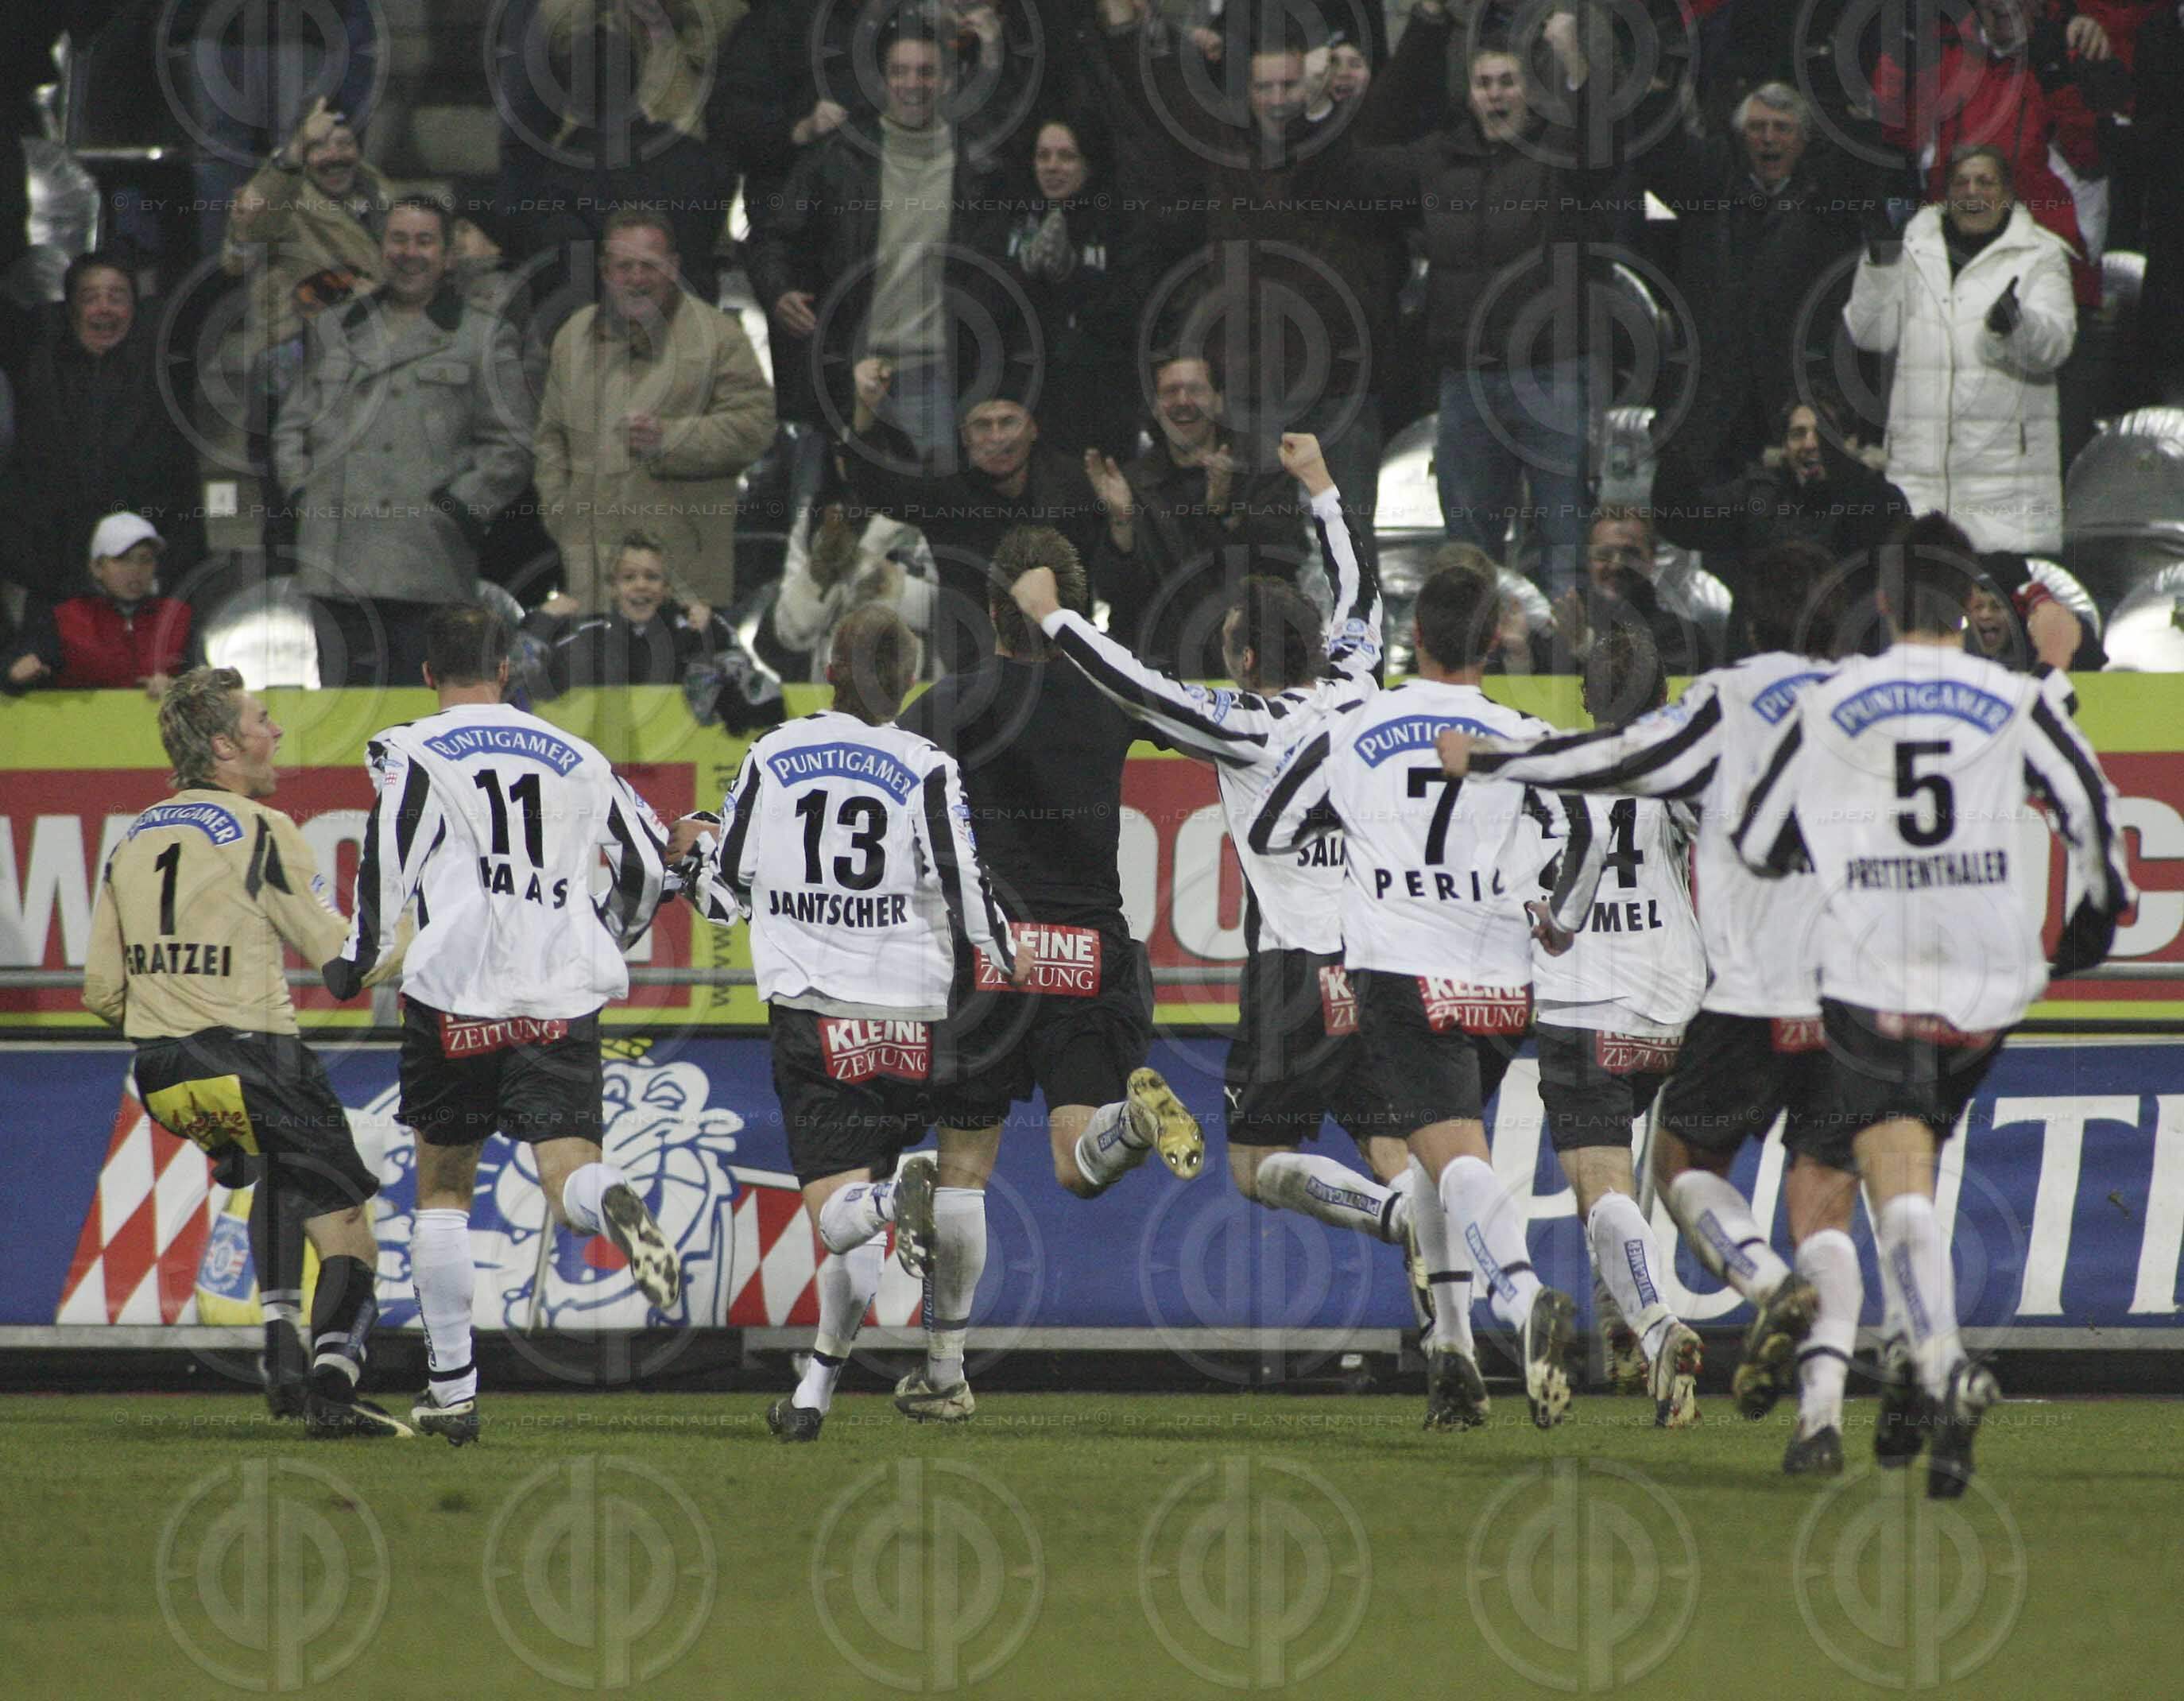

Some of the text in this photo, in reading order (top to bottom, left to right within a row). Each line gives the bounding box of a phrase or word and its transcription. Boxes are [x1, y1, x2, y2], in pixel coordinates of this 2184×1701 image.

[432, 729, 576, 771] PUNTIGAMER
[1358, 720, 1486, 760] PUNTI
[773, 748, 912, 798] PUNTIGAMER
[1895, 740, 1954, 848] 5
[472, 769, 544, 869] 11
[1407, 766, 1465, 865] 7
[795, 788, 888, 891] 13
[154, 843, 181, 936] 1
[769, 889, 908, 928] JANTSCHER
[986, 929, 1094, 962] EINE
[981, 962, 1094, 990] ZTUNG
[448, 1020, 561, 1052] ZEITUNG
[827, 1020, 927, 1052] KLEINE
[1625, 1240, 1657, 1306] UNTIGAMER
